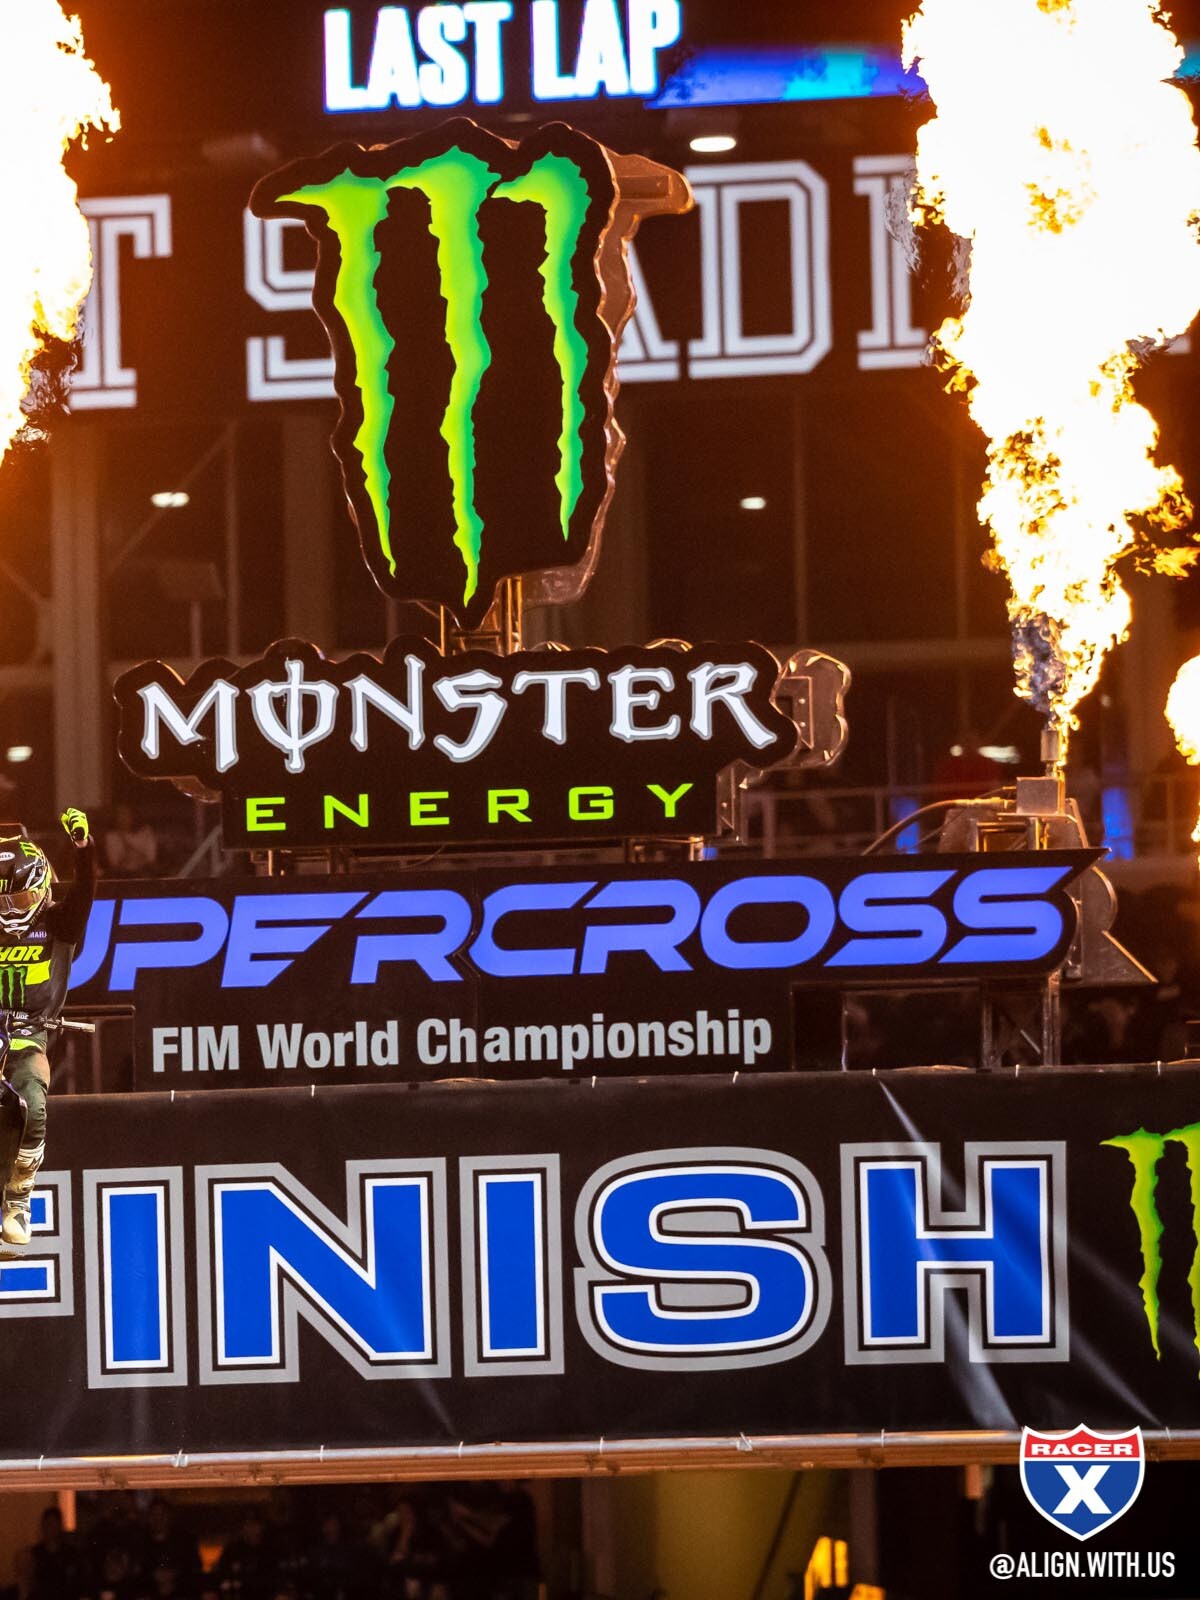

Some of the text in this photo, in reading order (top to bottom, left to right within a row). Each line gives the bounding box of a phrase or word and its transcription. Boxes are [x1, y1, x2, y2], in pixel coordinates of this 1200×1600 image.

[323, 0, 681, 113] LAST LAP
[137, 654, 778, 774] MONSTER
[246, 782, 694, 832] ENERGY
[152, 1008, 773, 1073] FIM World Championship
